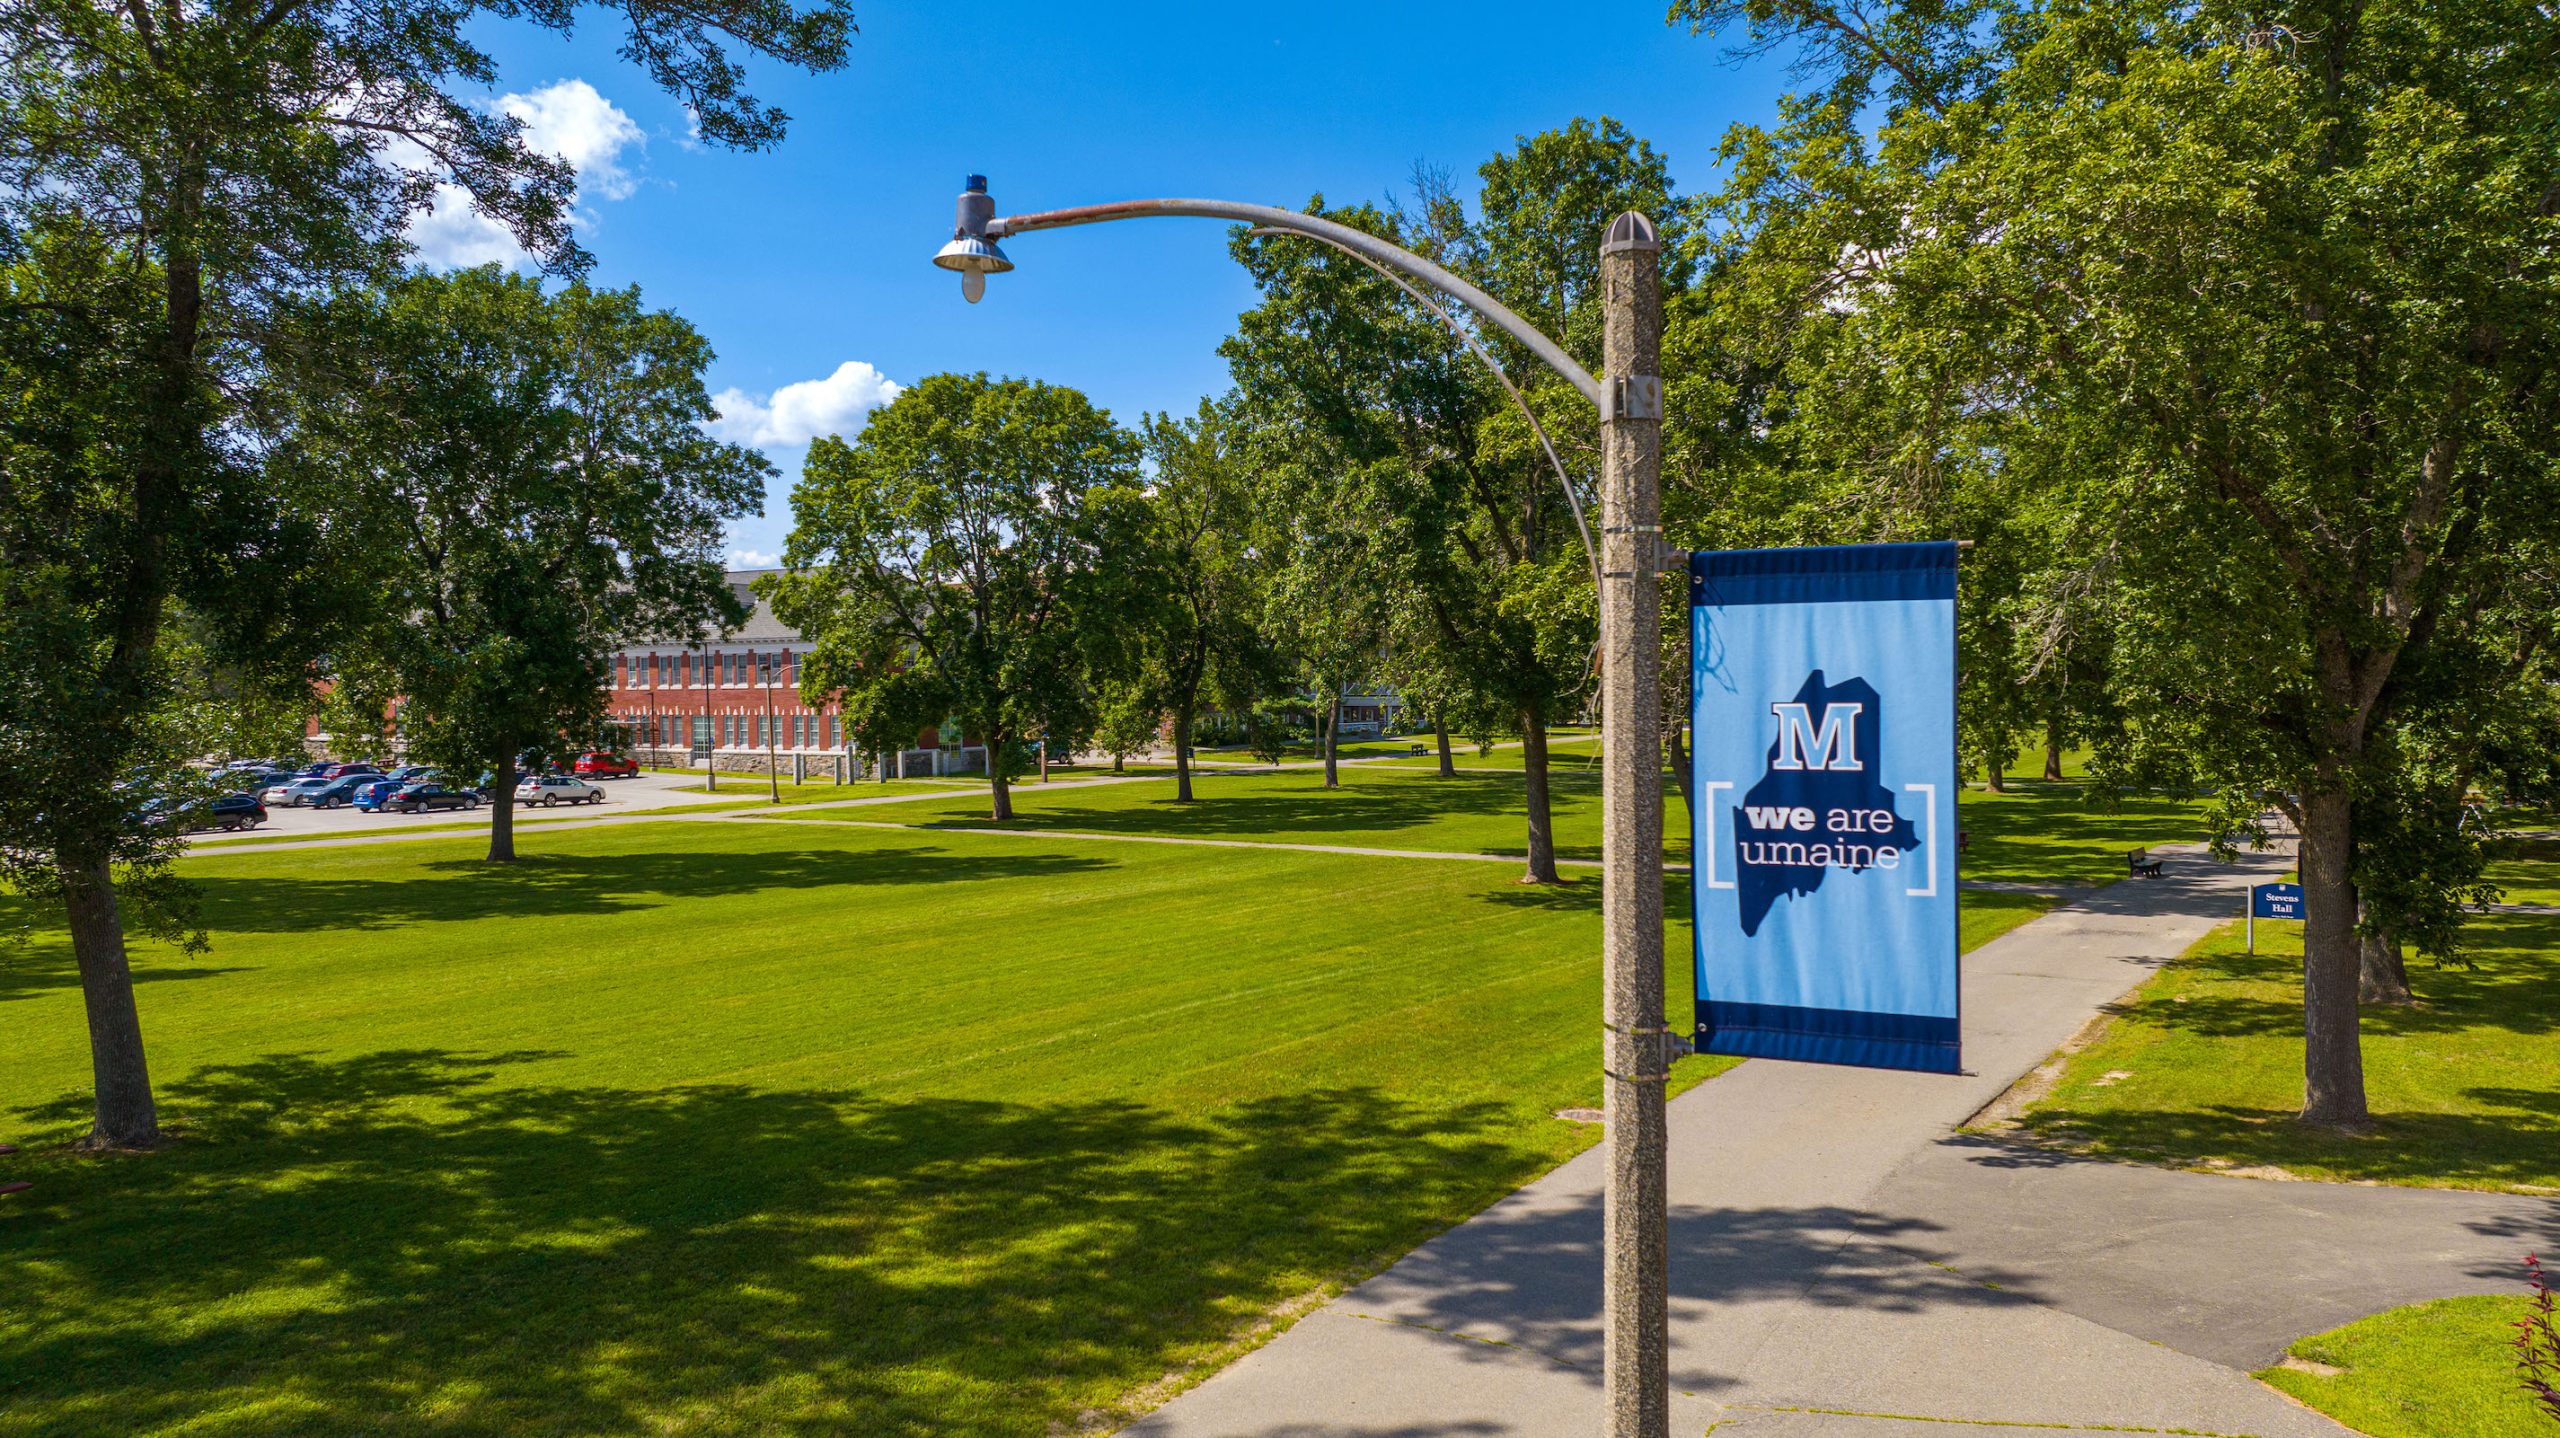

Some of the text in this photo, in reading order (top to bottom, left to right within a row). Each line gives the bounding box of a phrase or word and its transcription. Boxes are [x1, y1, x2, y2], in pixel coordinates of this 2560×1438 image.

[1771, 702, 1863, 771] M
[1744, 806, 1894, 834] we are
[1739, 836, 1900, 870] umaine
[2265, 892, 2300, 903] Stevens
[2272, 904, 2293, 913] Hall
